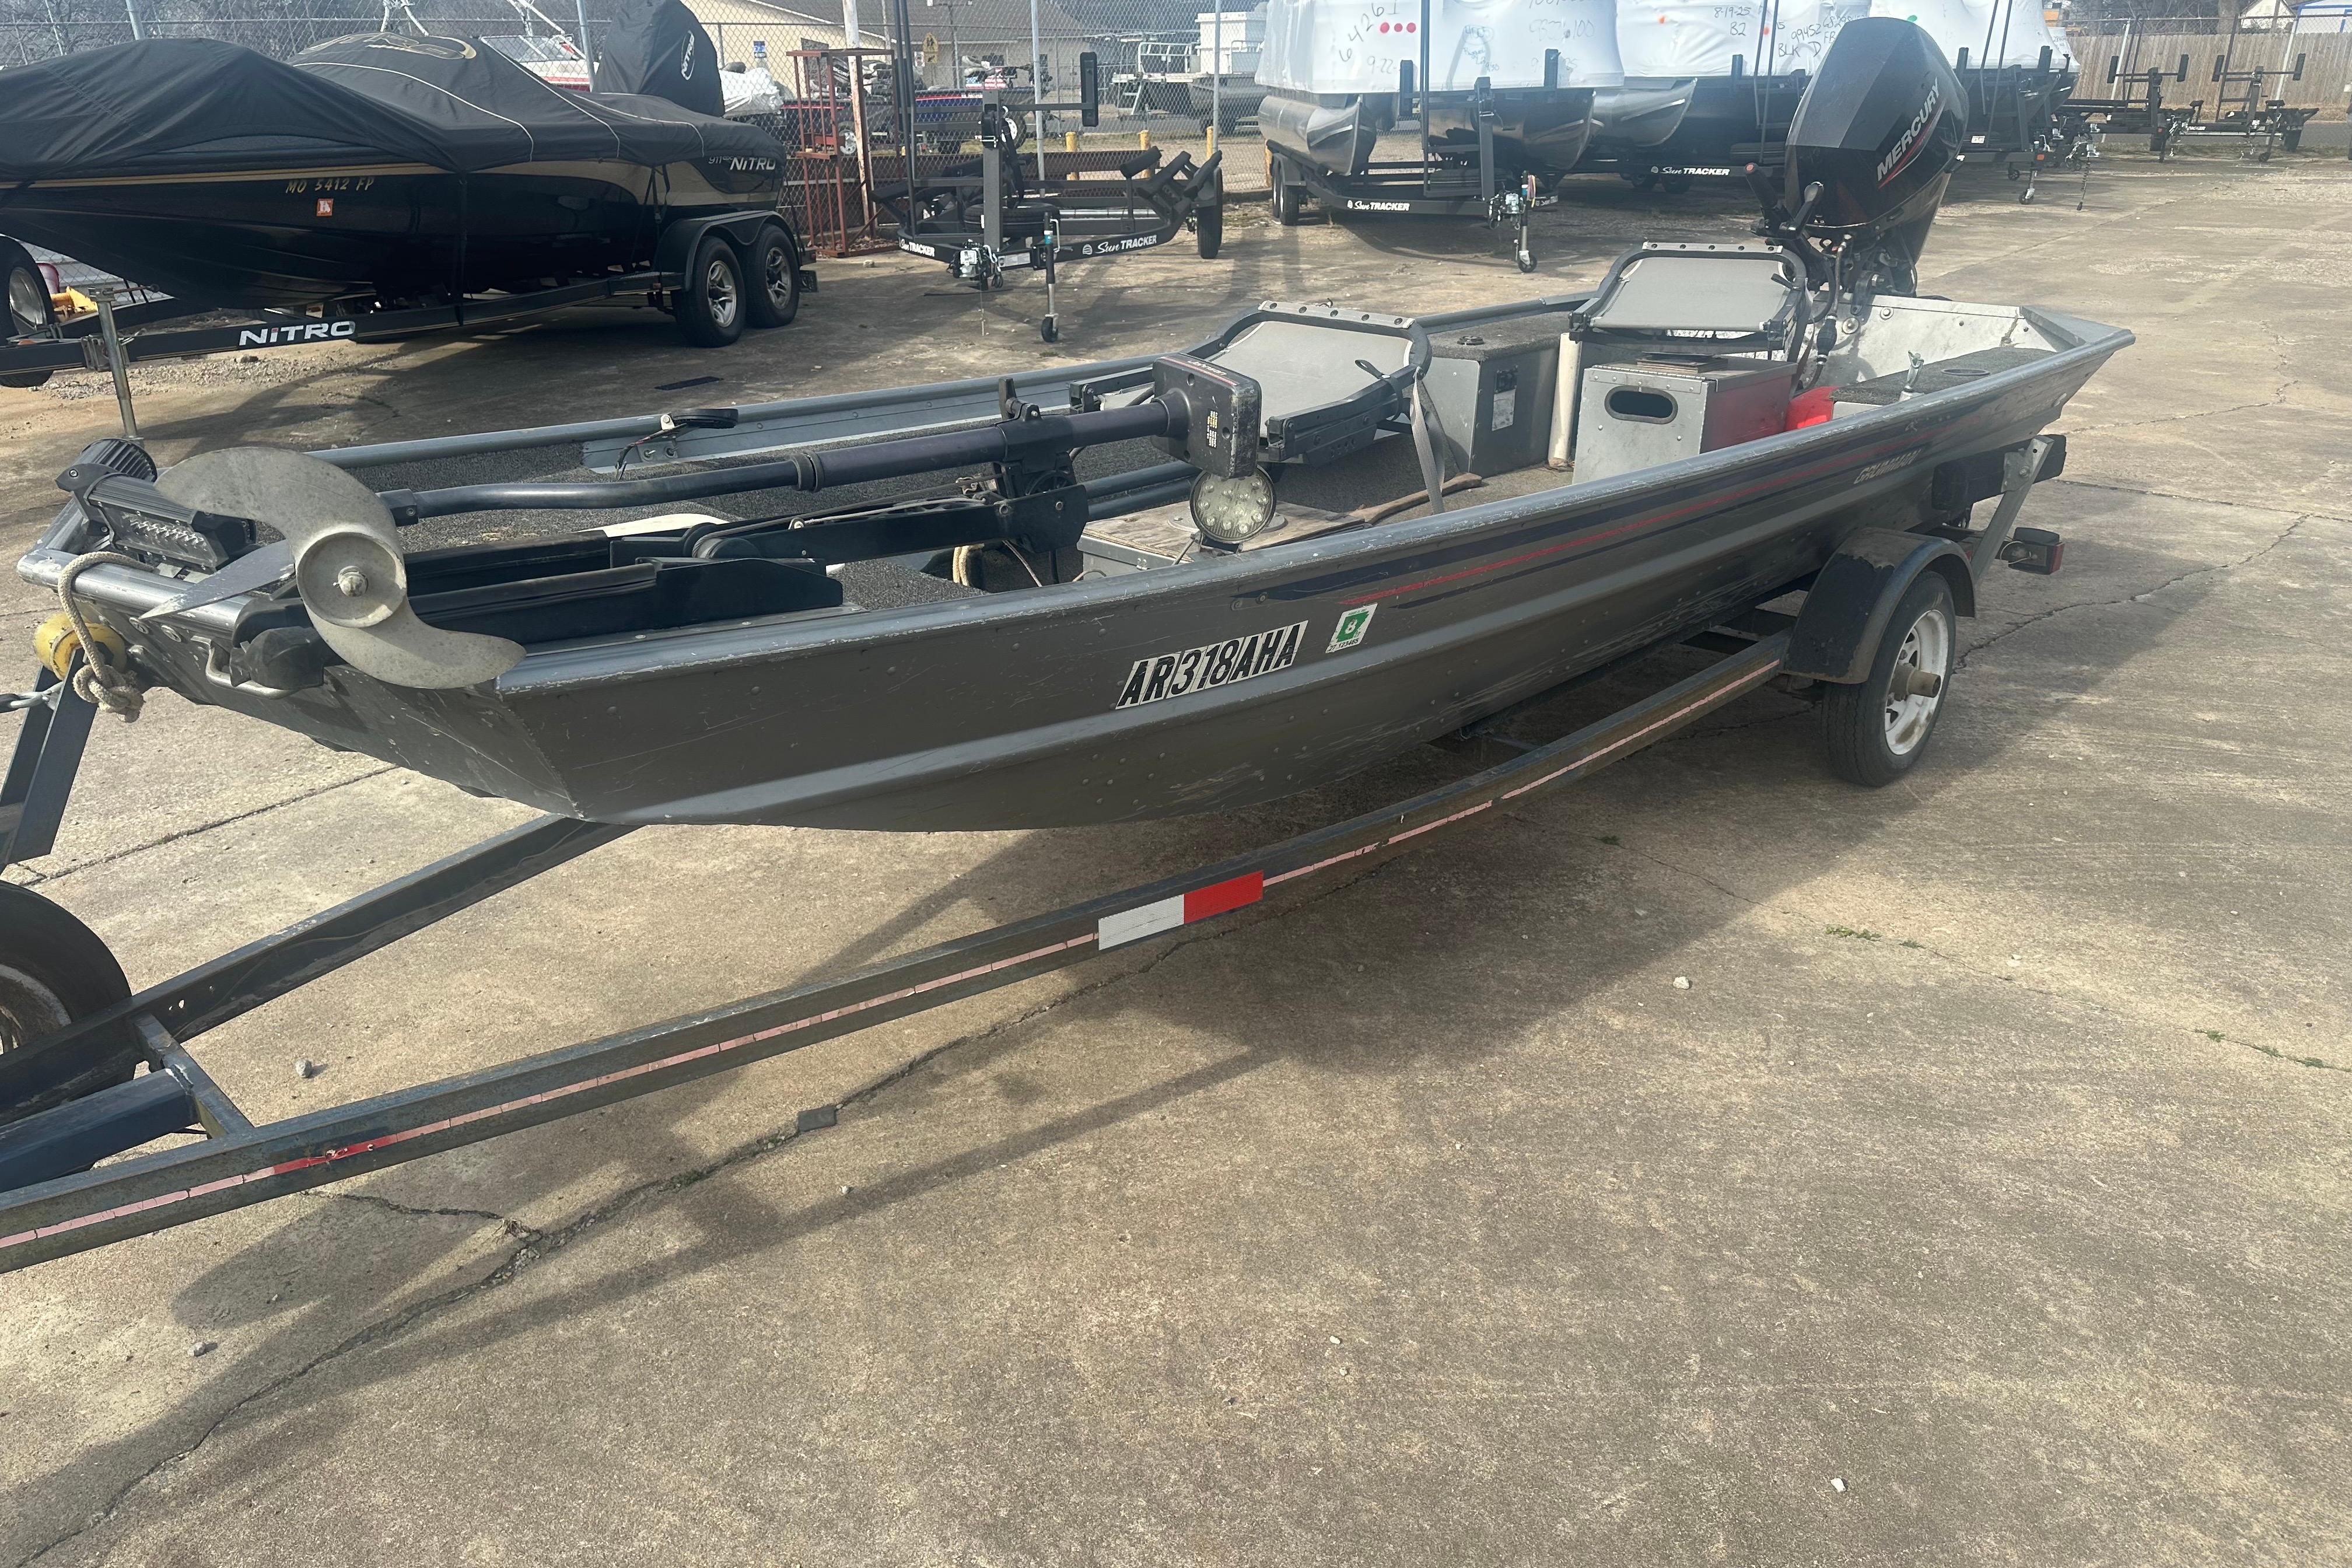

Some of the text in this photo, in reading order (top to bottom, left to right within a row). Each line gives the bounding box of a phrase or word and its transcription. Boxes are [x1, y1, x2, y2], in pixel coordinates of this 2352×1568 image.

[1877, 76, 1939, 181] MERCURY
[1661, 166, 1730, 176] Sun TRACKER
[285, 176, 375, 194] MO 5412 FP
[1354, 201, 1410, 211] Sun TRACKER
[909, 242, 935, 257] TRACKER
[1095, 235, 1157, 254] Sun TRACKER
[1188, 360, 1227, 376] Johnson
[1854, 449, 1922, 484] GRUMMAN
[1345, 619, 1357, 634] 8
